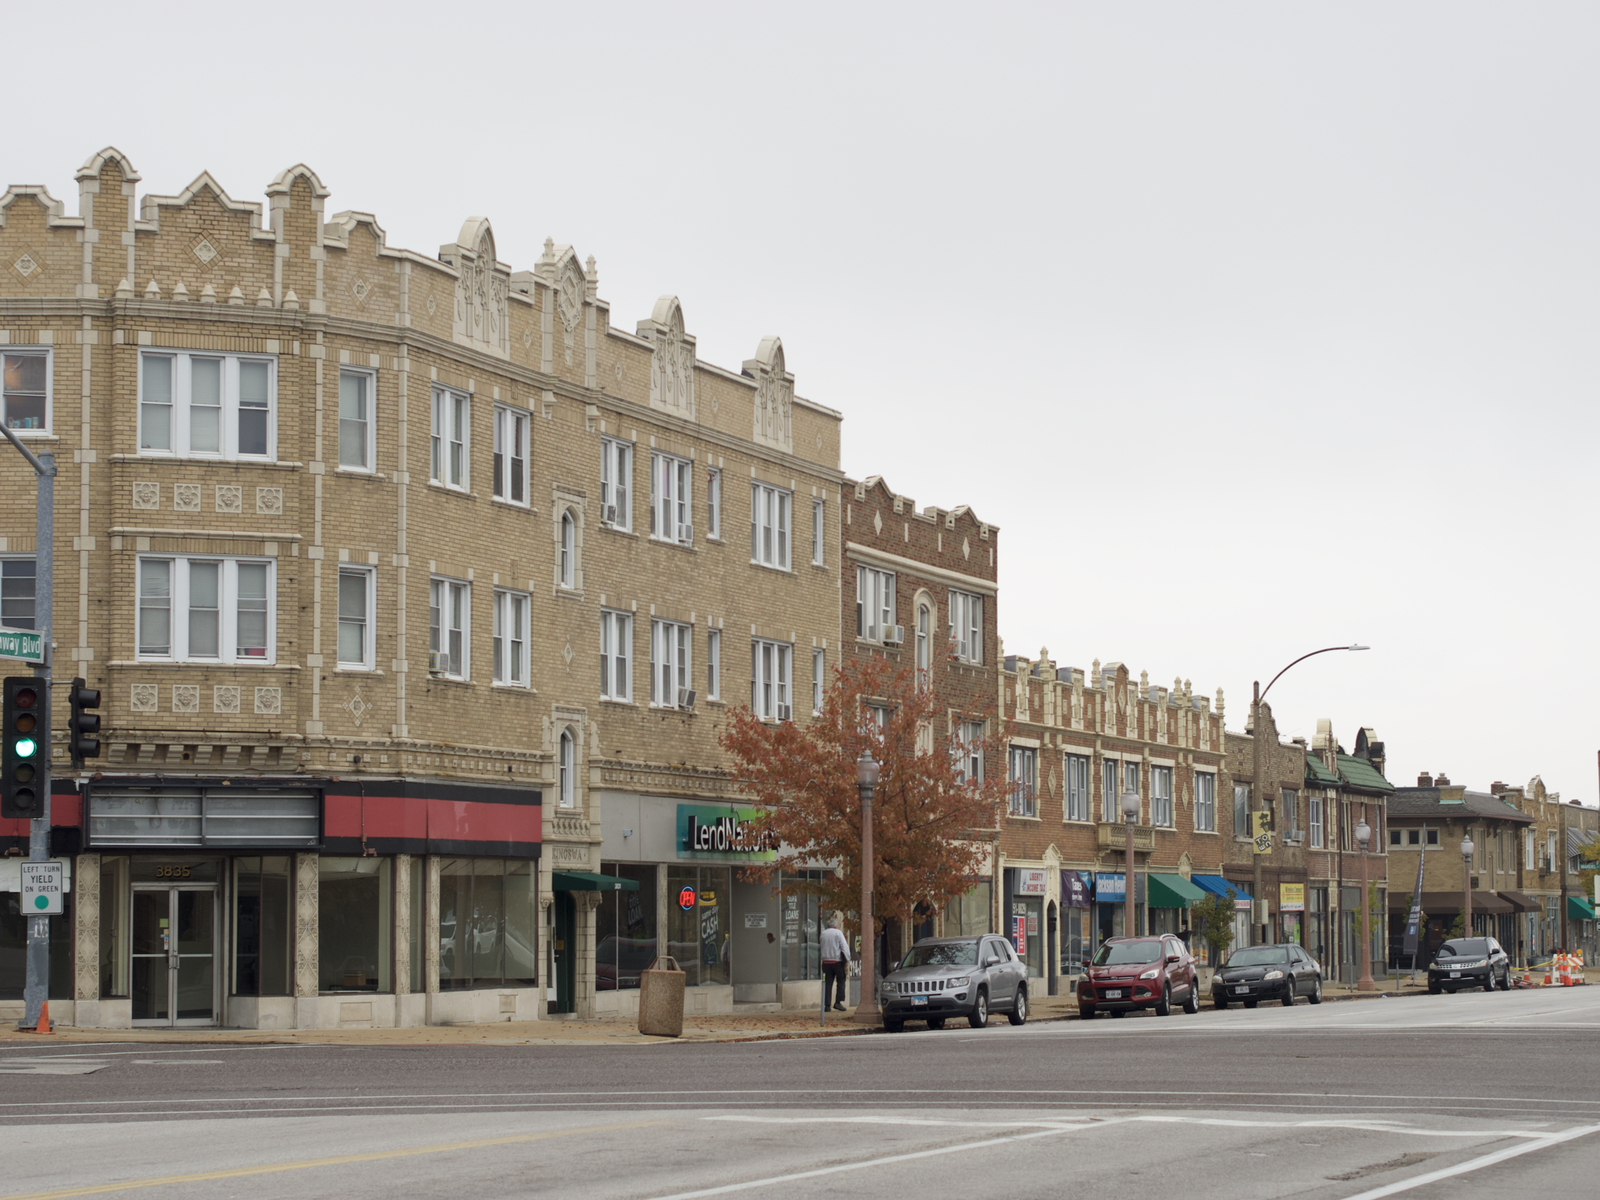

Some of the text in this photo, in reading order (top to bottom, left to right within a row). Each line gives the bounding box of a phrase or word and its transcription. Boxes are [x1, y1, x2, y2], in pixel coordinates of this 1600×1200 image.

[0, 636, 40, 656] way Blvd
[156, 866, 192, 877] 3835
[1029, 872, 1043, 881] LIBERTY
[31, 875, 53, 883] YIELD
[679, 891, 696, 906] OPEN
[786, 910, 799, 919] LOANS
[702, 914, 719, 939] CASH
